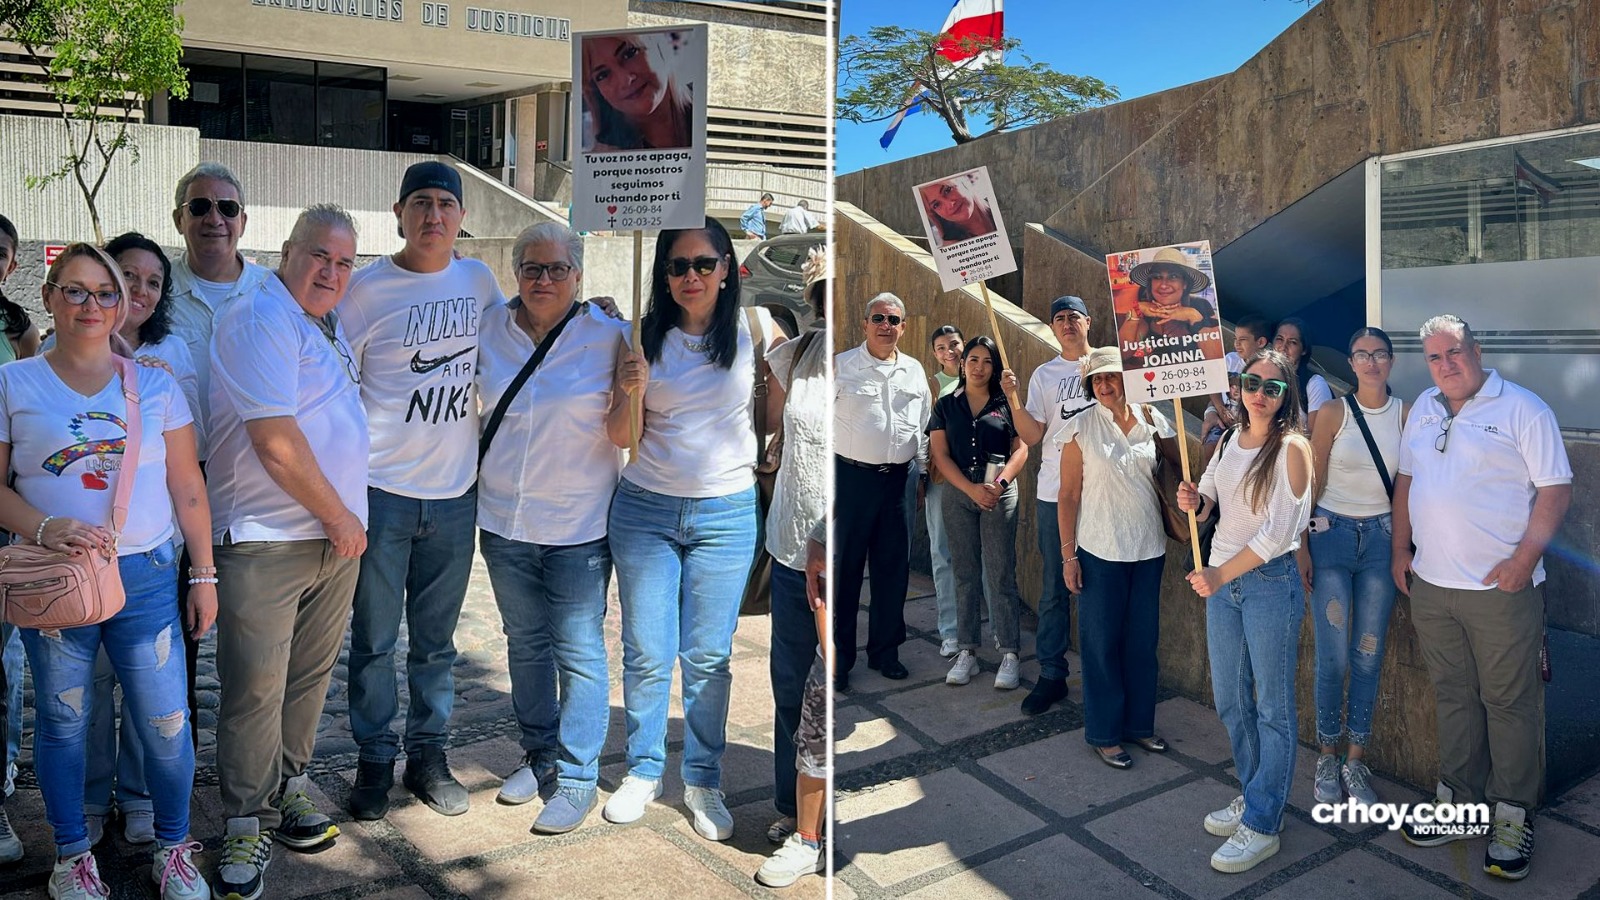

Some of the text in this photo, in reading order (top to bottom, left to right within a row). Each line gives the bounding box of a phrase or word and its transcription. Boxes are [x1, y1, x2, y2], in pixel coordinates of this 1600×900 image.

[422, 4, 448, 25] DE
[466, 9, 569, 39] JUSTICIA
[585, 155, 597, 163] Tu
[650, 152, 692, 162] apaga,
[594, 166, 682, 178] porque nosotros
[611, 180, 664, 190] seguimos
[595, 191, 680, 203] luchando por ti
[622, 205, 662, 214] 26-09-84
[622, 217, 662, 226] 02-03-25
[946, 242, 996, 260] porque nosotros
[959, 251, 988, 264] seguimos
[951, 261, 982, 273] luchando
[403, 297, 477, 347] NIKE
[1122, 331, 1220, 352] Justicia para
[1142, 348, 1205, 368] JOANNA
[442, 362, 471, 378] AIR
[1162, 366, 1205, 380] 26-09-84
[1163, 380, 1208, 394] 02-03-25
[405, 382, 472, 424] NIKE
